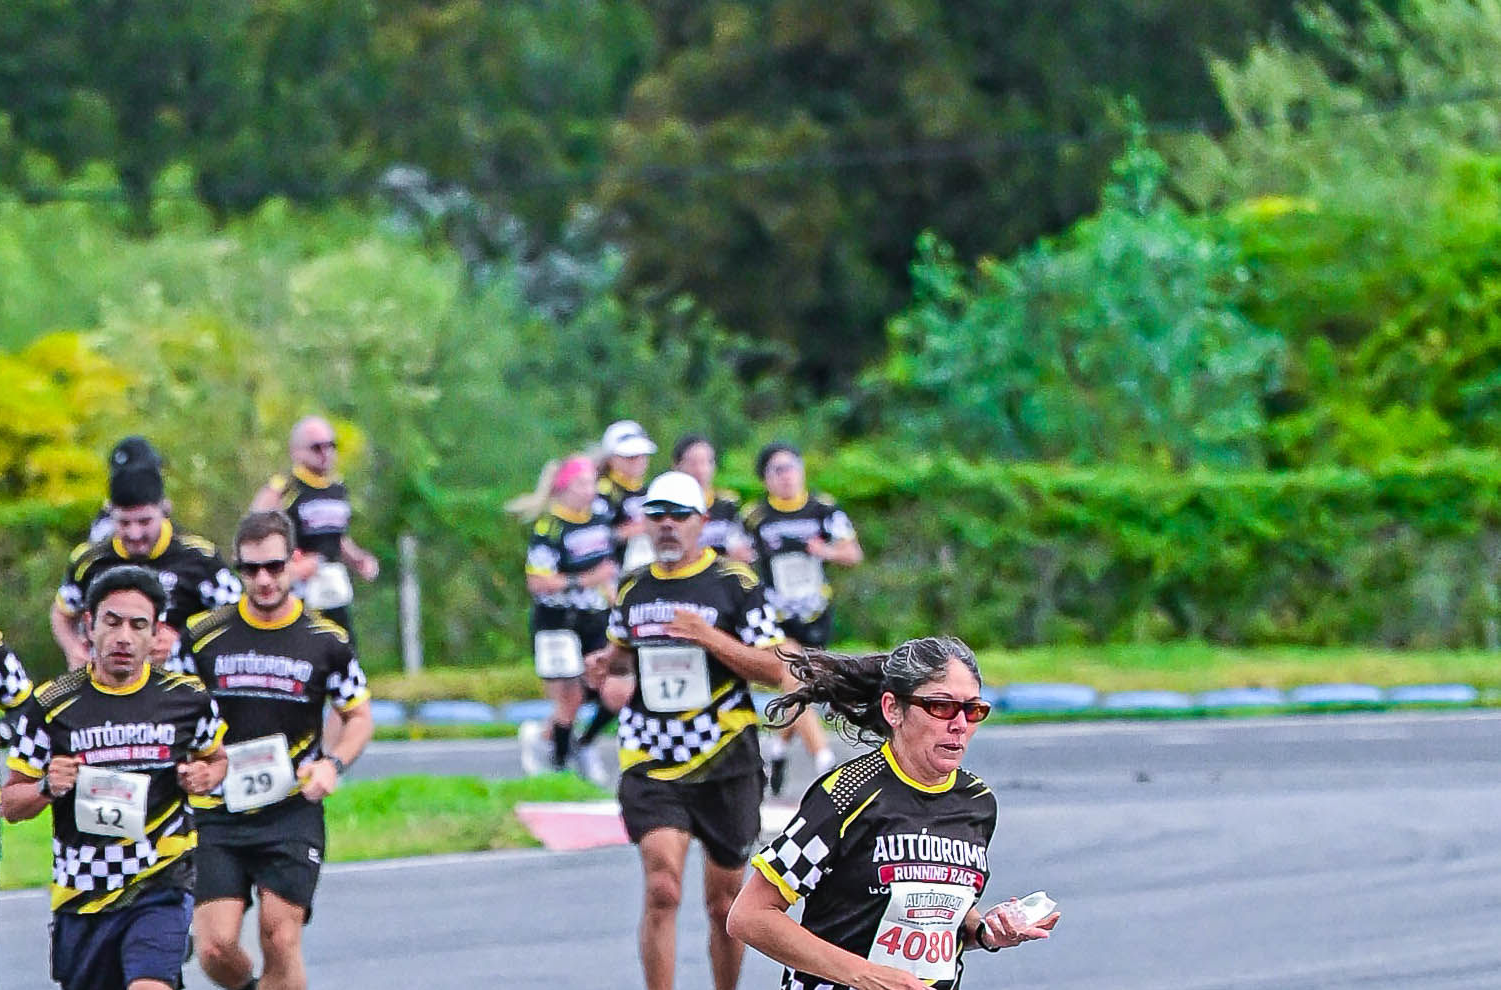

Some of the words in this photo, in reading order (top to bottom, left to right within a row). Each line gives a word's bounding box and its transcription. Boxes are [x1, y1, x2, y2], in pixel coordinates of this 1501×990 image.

[659, 679, 687, 699] 17
[70, 720, 176, 752] AUTÓDROMO
[242, 772, 273, 796] 29
[95, 807, 125, 829] 12
[872, 828, 987, 872] AUTÓDROMO
[894, 865, 948, 882] RUNNING
[949, 868, 977, 886] RACE
[869, 886, 878, 894] La
[905, 889, 964, 910] AUTÓDROMO
[876, 925, 954, 963] 4080
